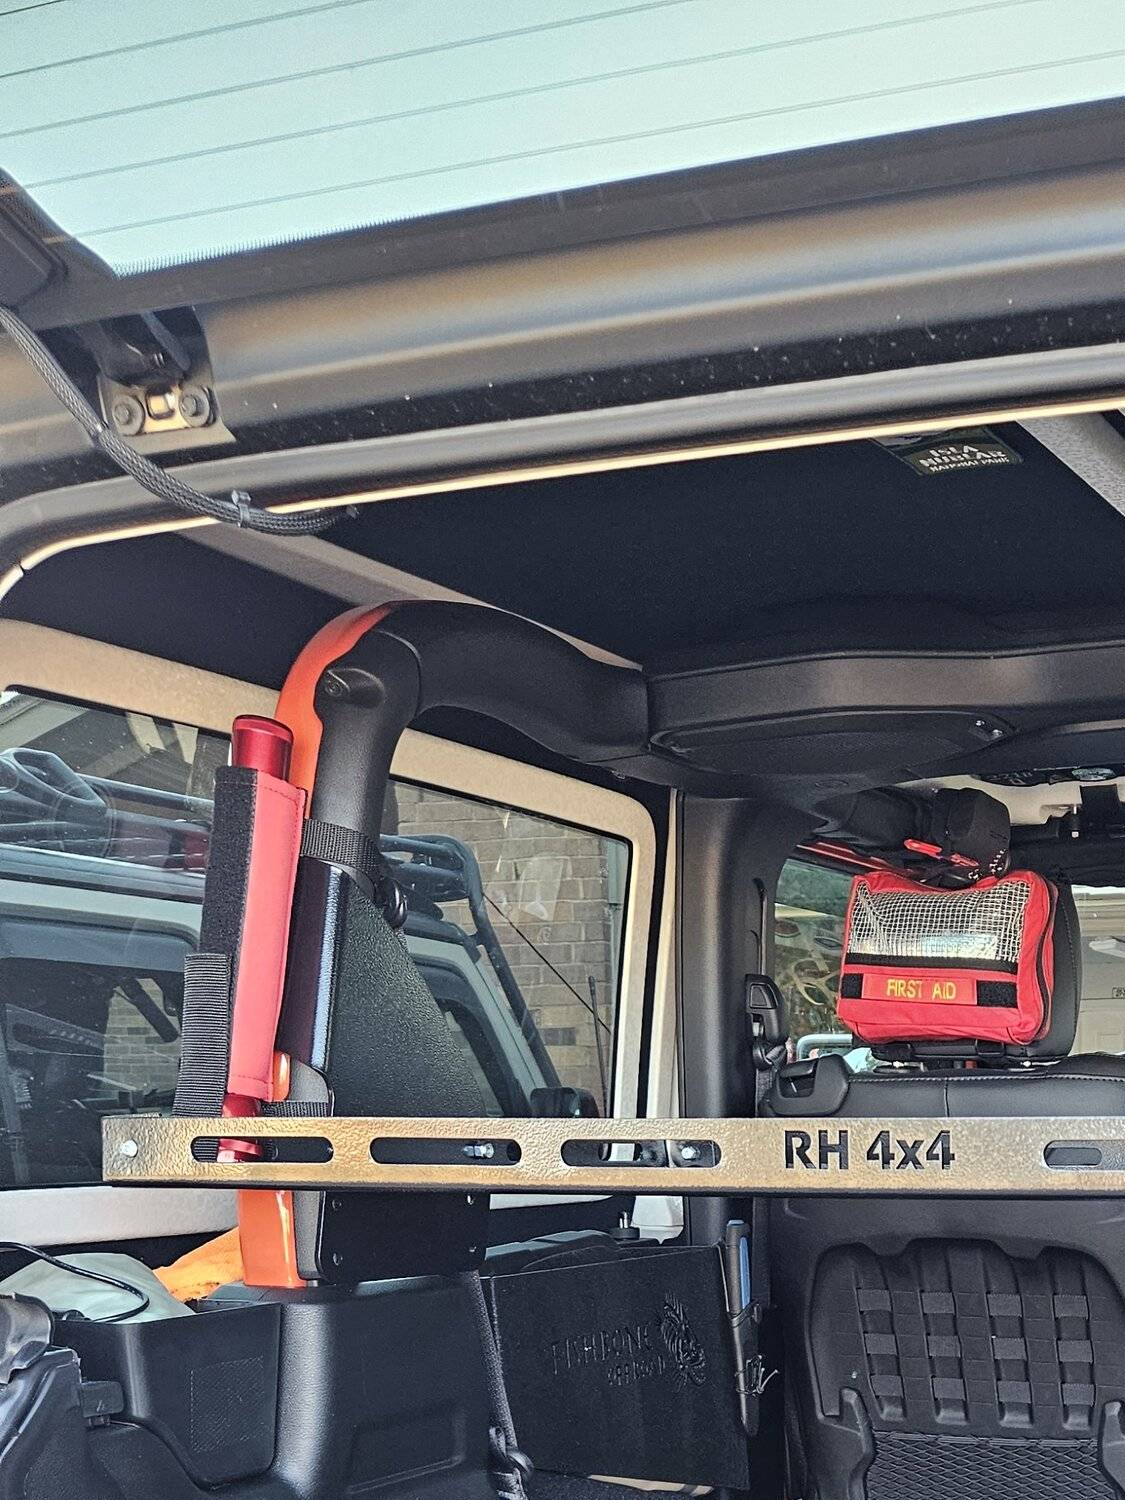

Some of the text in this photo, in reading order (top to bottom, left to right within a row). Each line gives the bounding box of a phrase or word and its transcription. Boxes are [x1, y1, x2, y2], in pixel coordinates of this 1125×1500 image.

[919, 451, 1006, 467] NUBLAR
[929, 445, 979, 457] ISLA
[886, 979, 956, 1000] FIRST AID
[784, 1130, 955, 1170] RH 4x4
